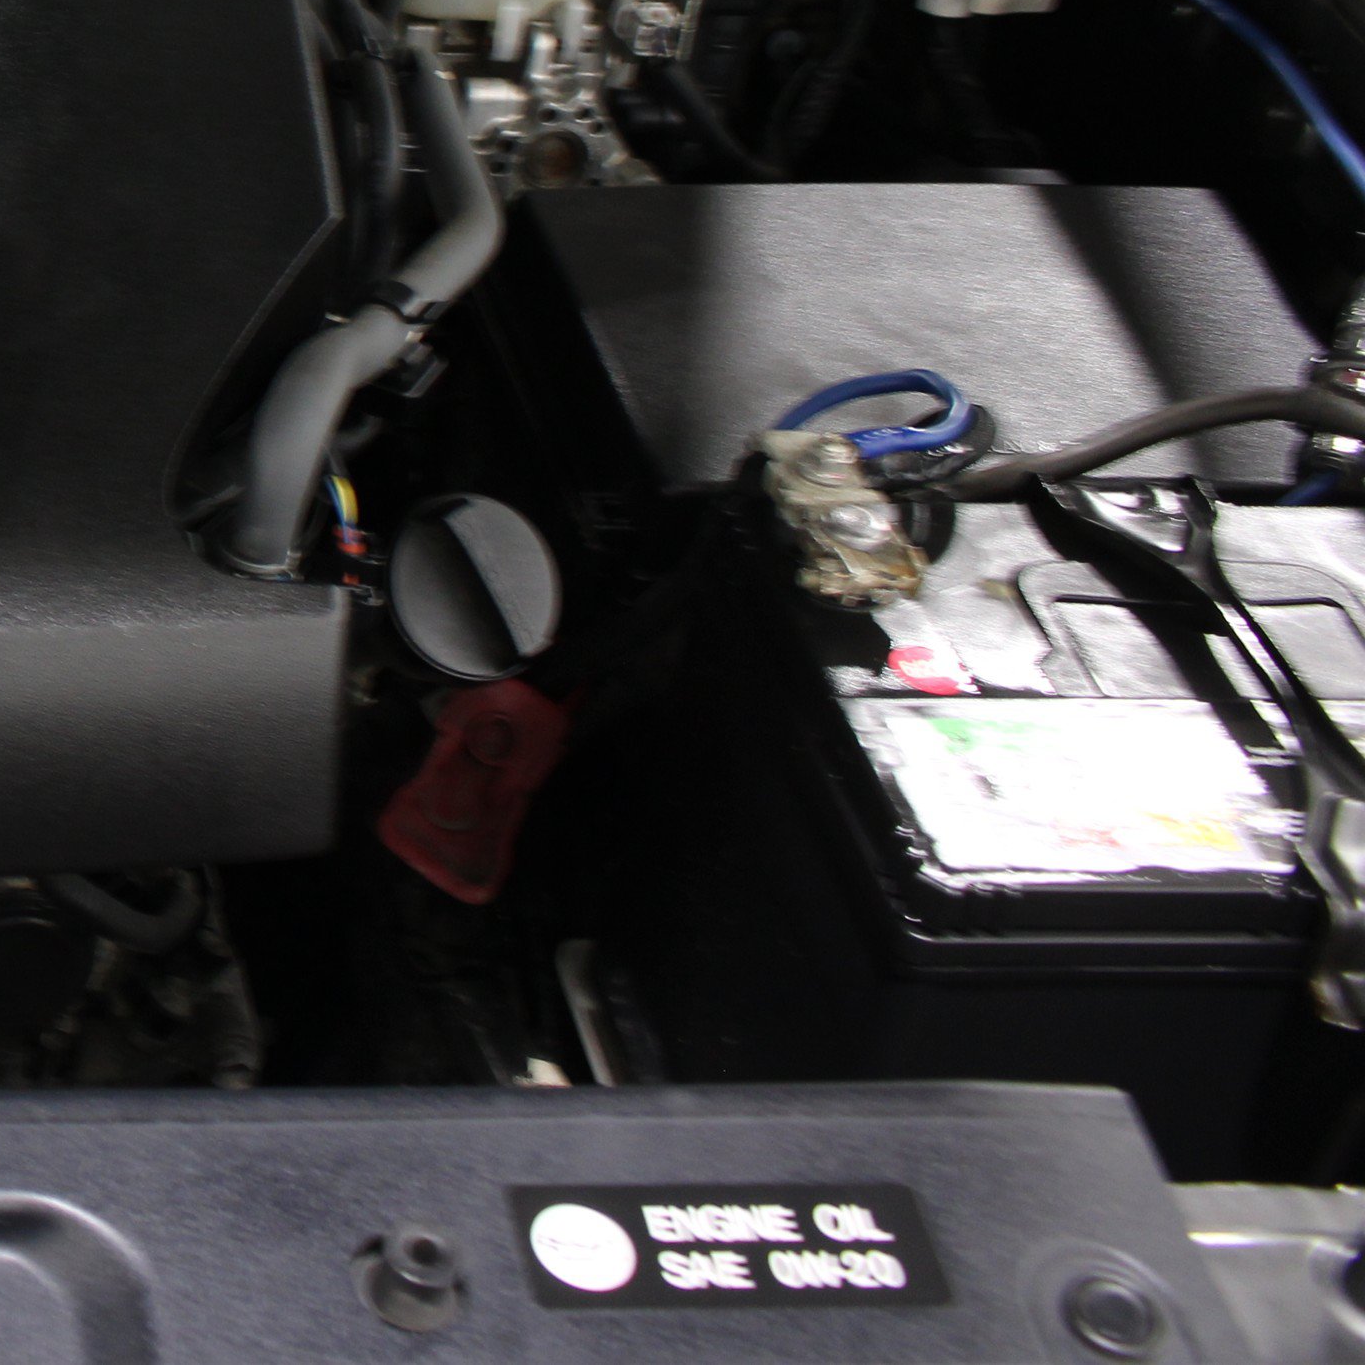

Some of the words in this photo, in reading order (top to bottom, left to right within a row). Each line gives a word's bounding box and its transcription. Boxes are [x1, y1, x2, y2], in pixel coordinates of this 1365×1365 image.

[641, 1204, 804, 1243] ENGINE
[812, 1203, 896, 1243] OIL
[657, 1251, 757, 1290] SAE
[768, 1250, 908, 1290] 0W-20
